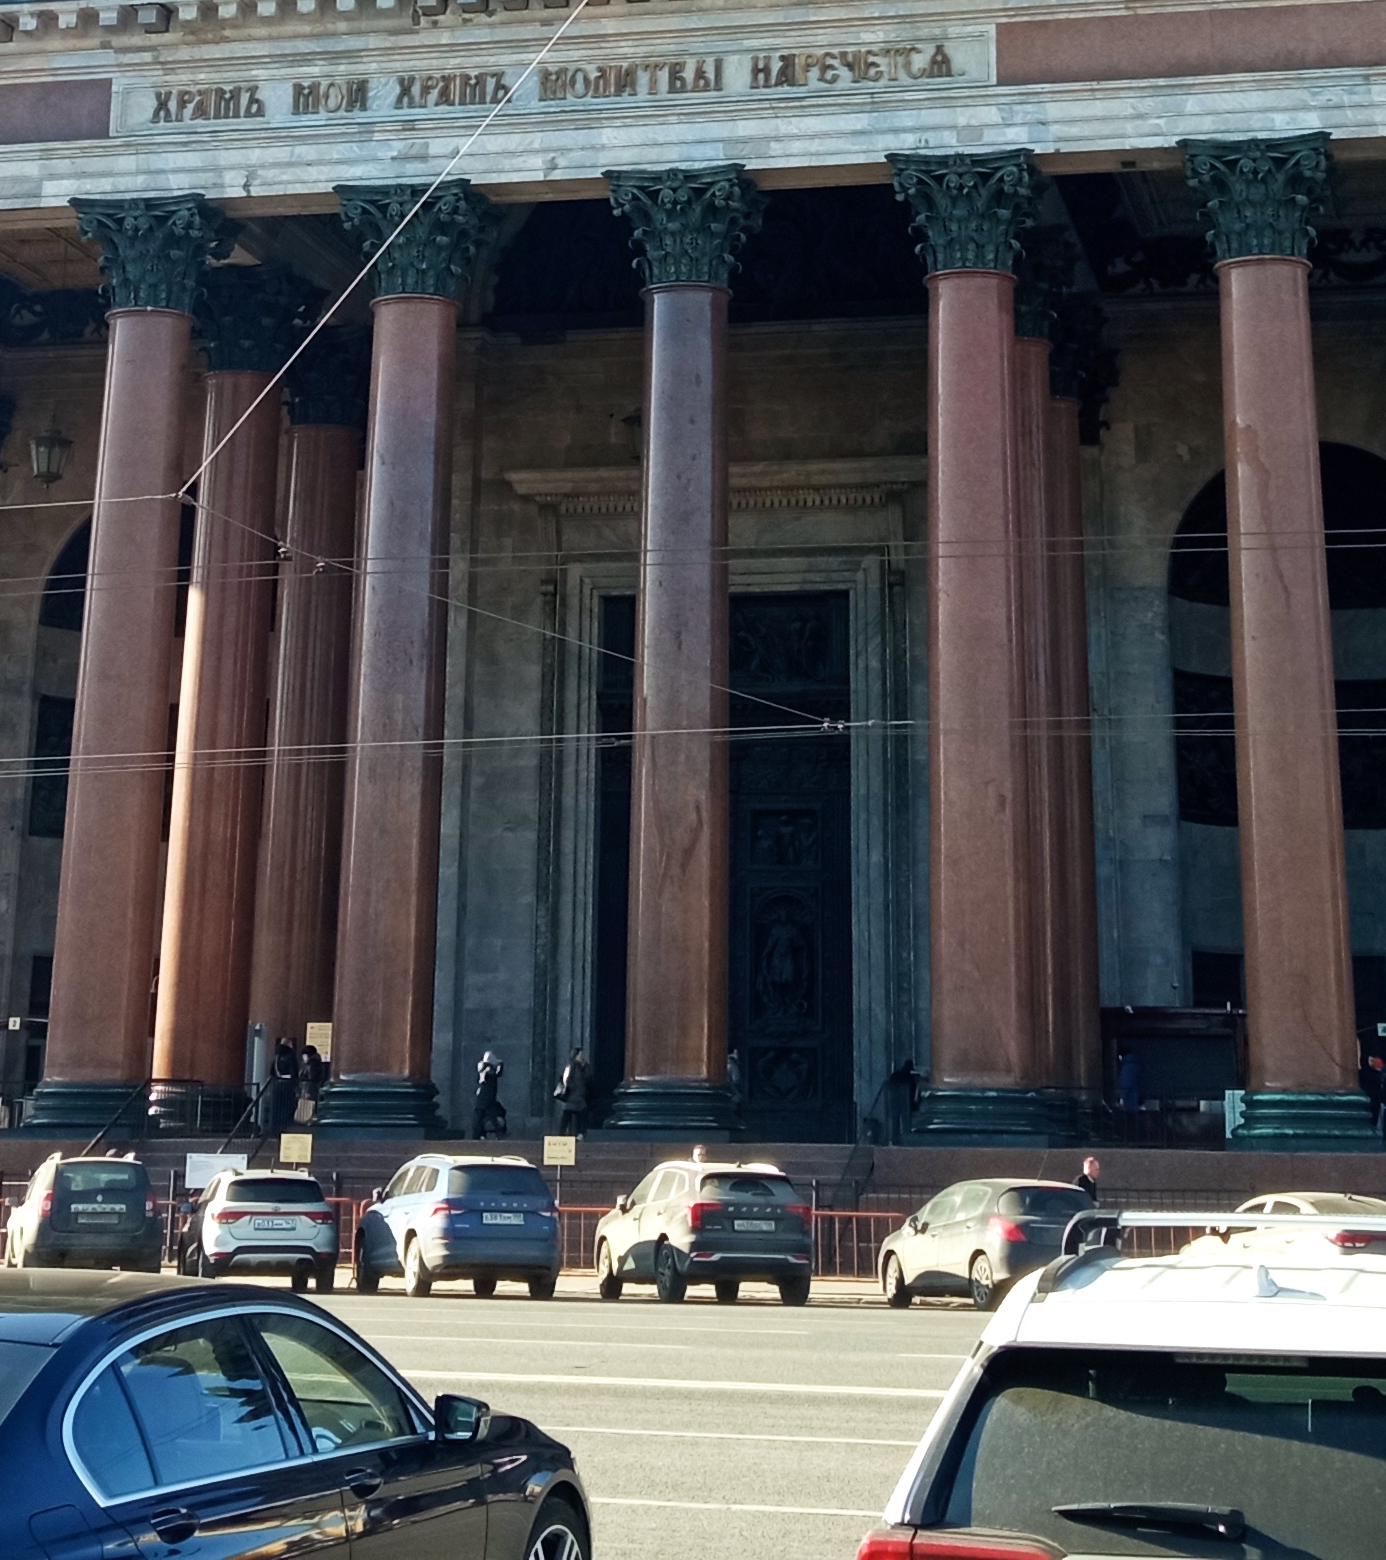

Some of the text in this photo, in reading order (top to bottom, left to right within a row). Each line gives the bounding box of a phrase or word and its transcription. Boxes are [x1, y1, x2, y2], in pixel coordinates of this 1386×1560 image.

[149, 85, 266, 124] ХРАМЪ
[394, 70, 513, 109] ХРАМЪ
[537, 56, 724, 102] МОЛИТВЫ
